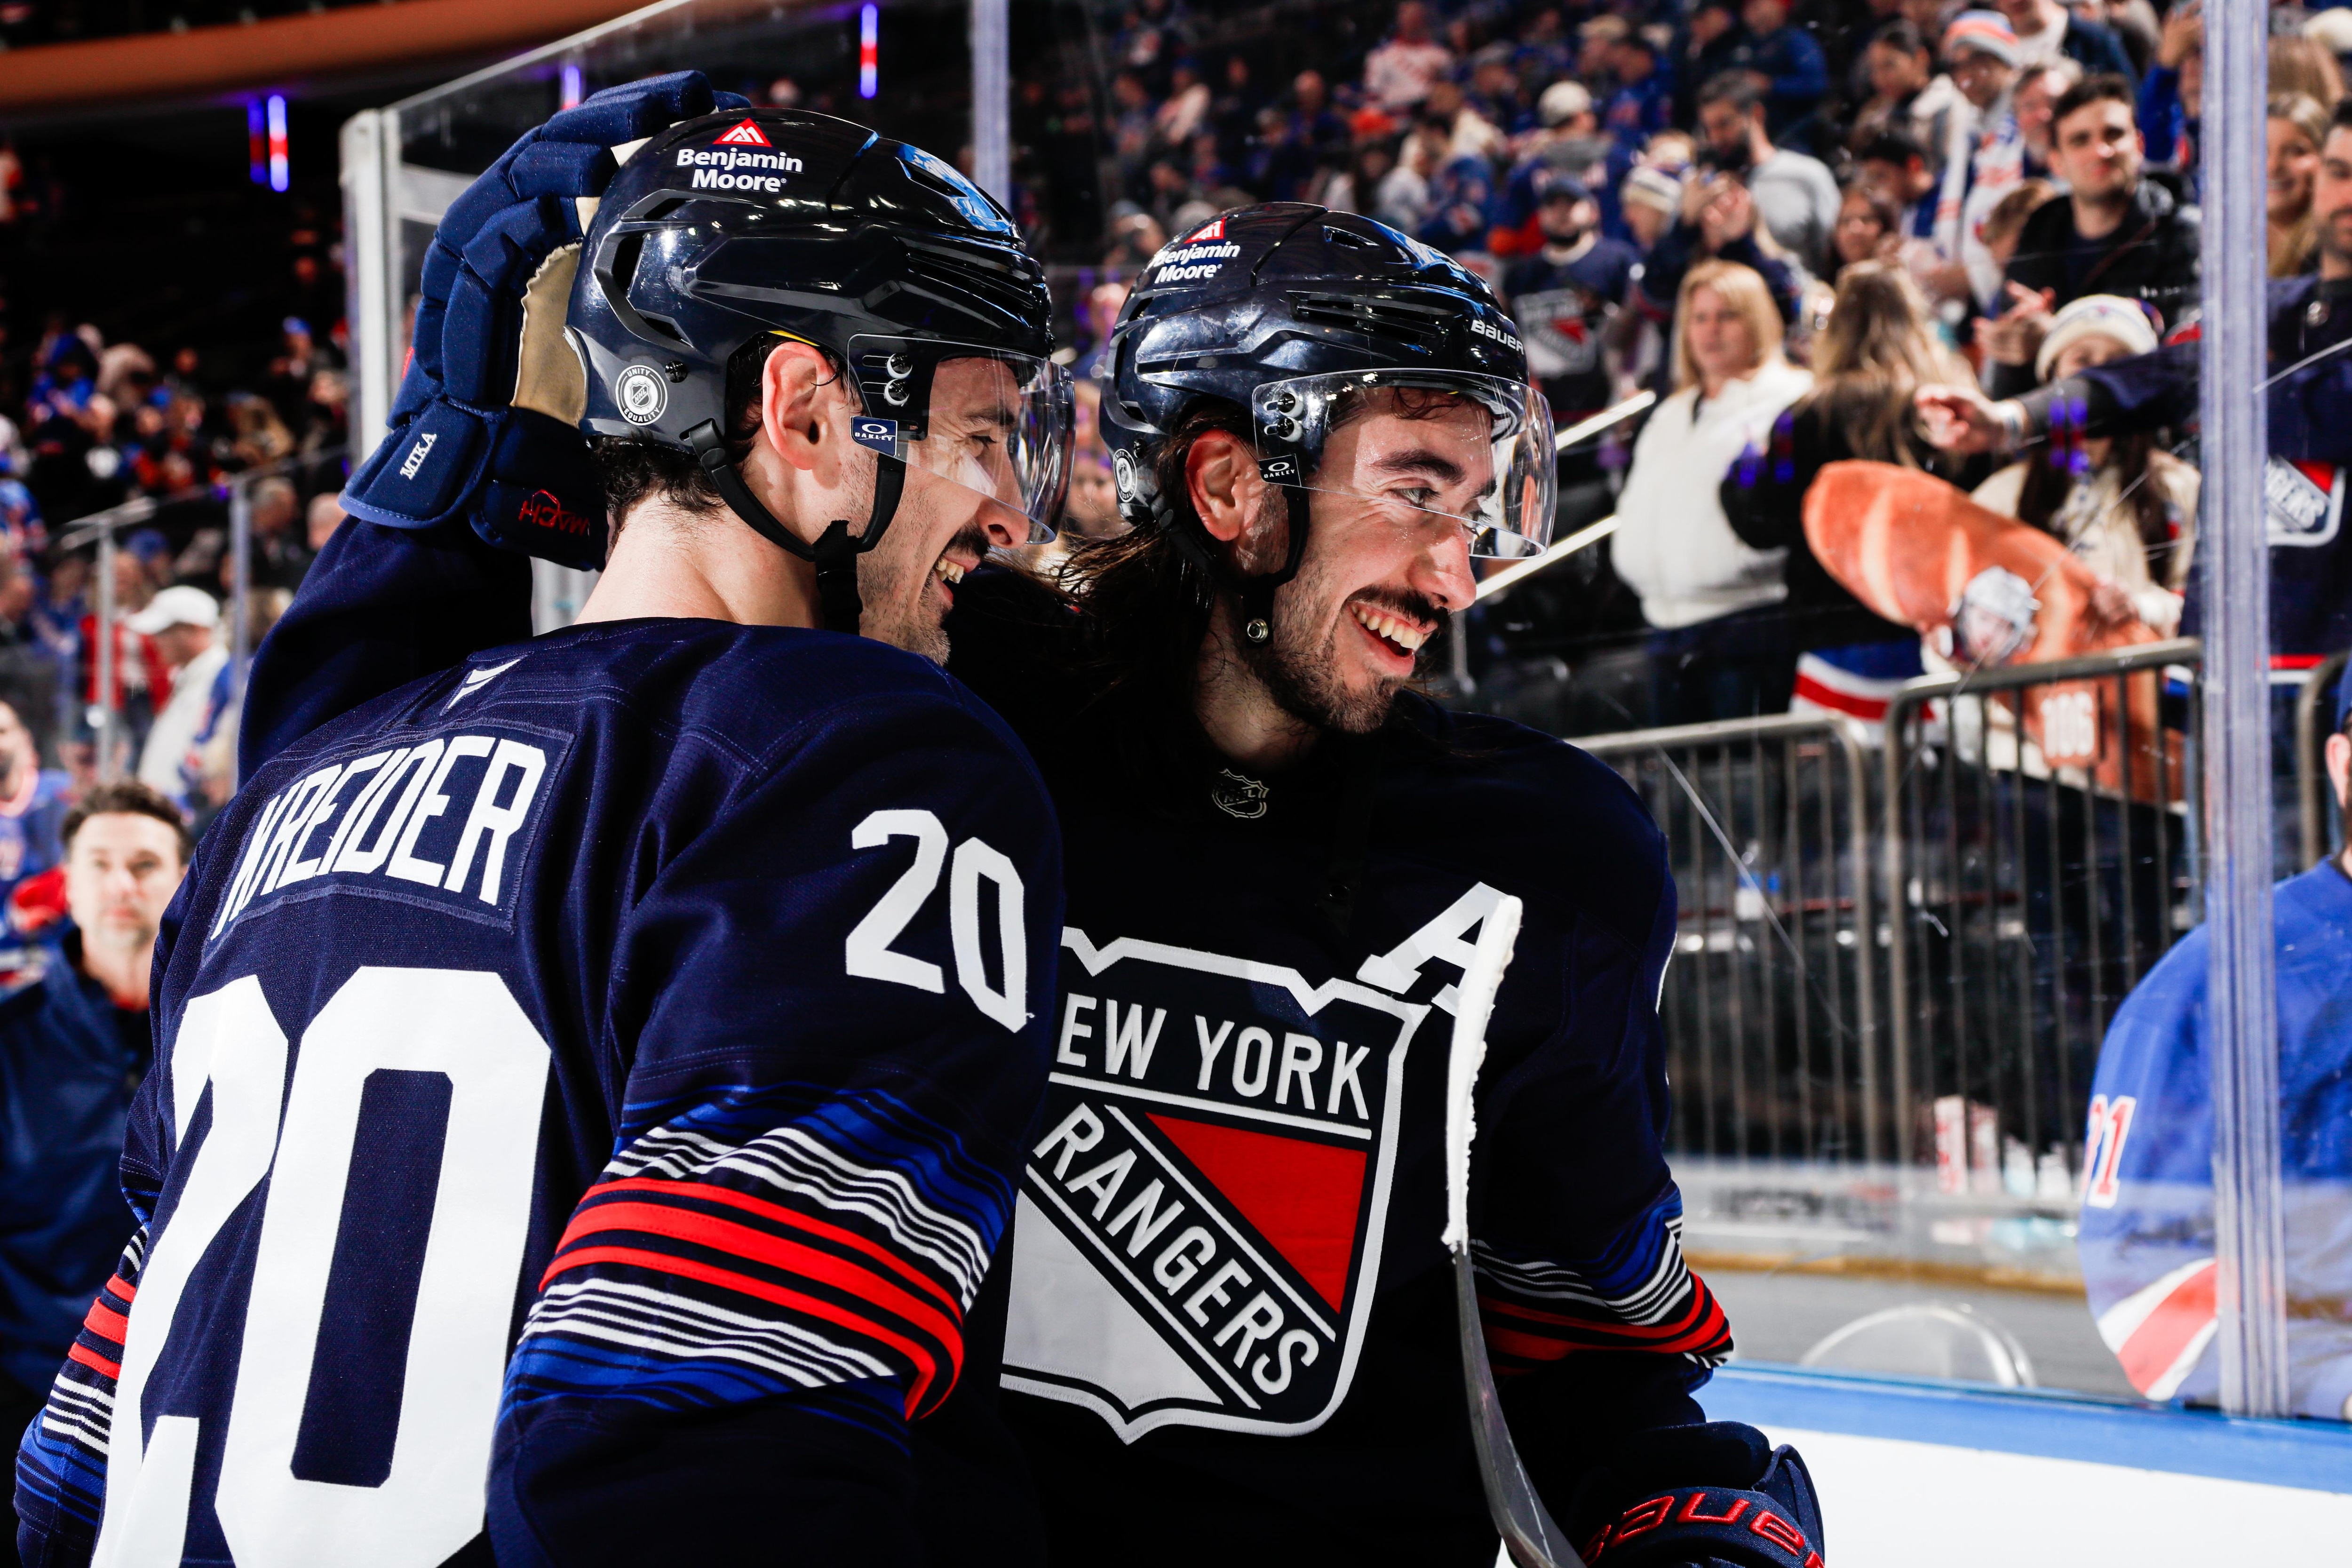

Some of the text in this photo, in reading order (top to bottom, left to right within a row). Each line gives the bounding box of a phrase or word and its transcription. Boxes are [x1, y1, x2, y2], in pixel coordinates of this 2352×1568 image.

[676, 147, 803, 172] Benjamin
[1153, 241, 1240, 267] Benjamin
[627, 368, 651, 377] UNITY
[634, 389, 647, 404] NHL
[624, 406, 660, 422] EQUALITY
[854, 432, 893, 441] OAKLEY
[399, 433, 437, 480] MIKA
[1263, 469, 1295, 479] OAKLEY
[1224, 789, 1256, 803] NL
[210, 735, 546, 941] KREIDER
[846, 809, 1027, 1034] 20
[1356, 881, 1496, 1018] A
[1057, 992, 1370, 1120] EW YORK
[1032, 1102, 1319, 1395] RANGERS
[89, 966, 551, 1568] 20
